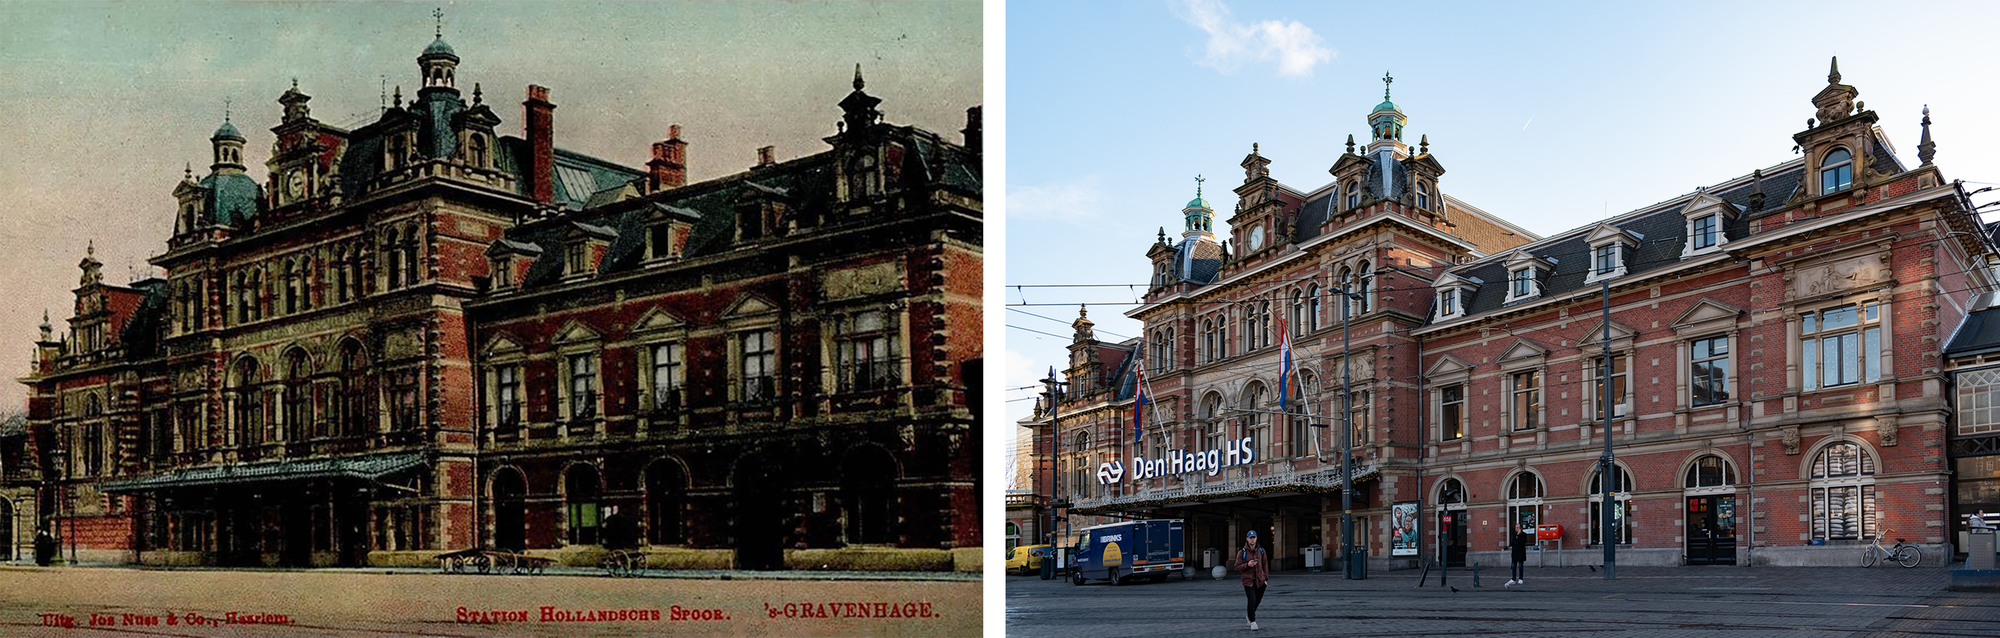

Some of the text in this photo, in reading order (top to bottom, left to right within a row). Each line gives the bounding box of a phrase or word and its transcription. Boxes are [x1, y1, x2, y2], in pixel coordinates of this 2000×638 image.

[1133, 437, 1255, 481] Den Haag HS
